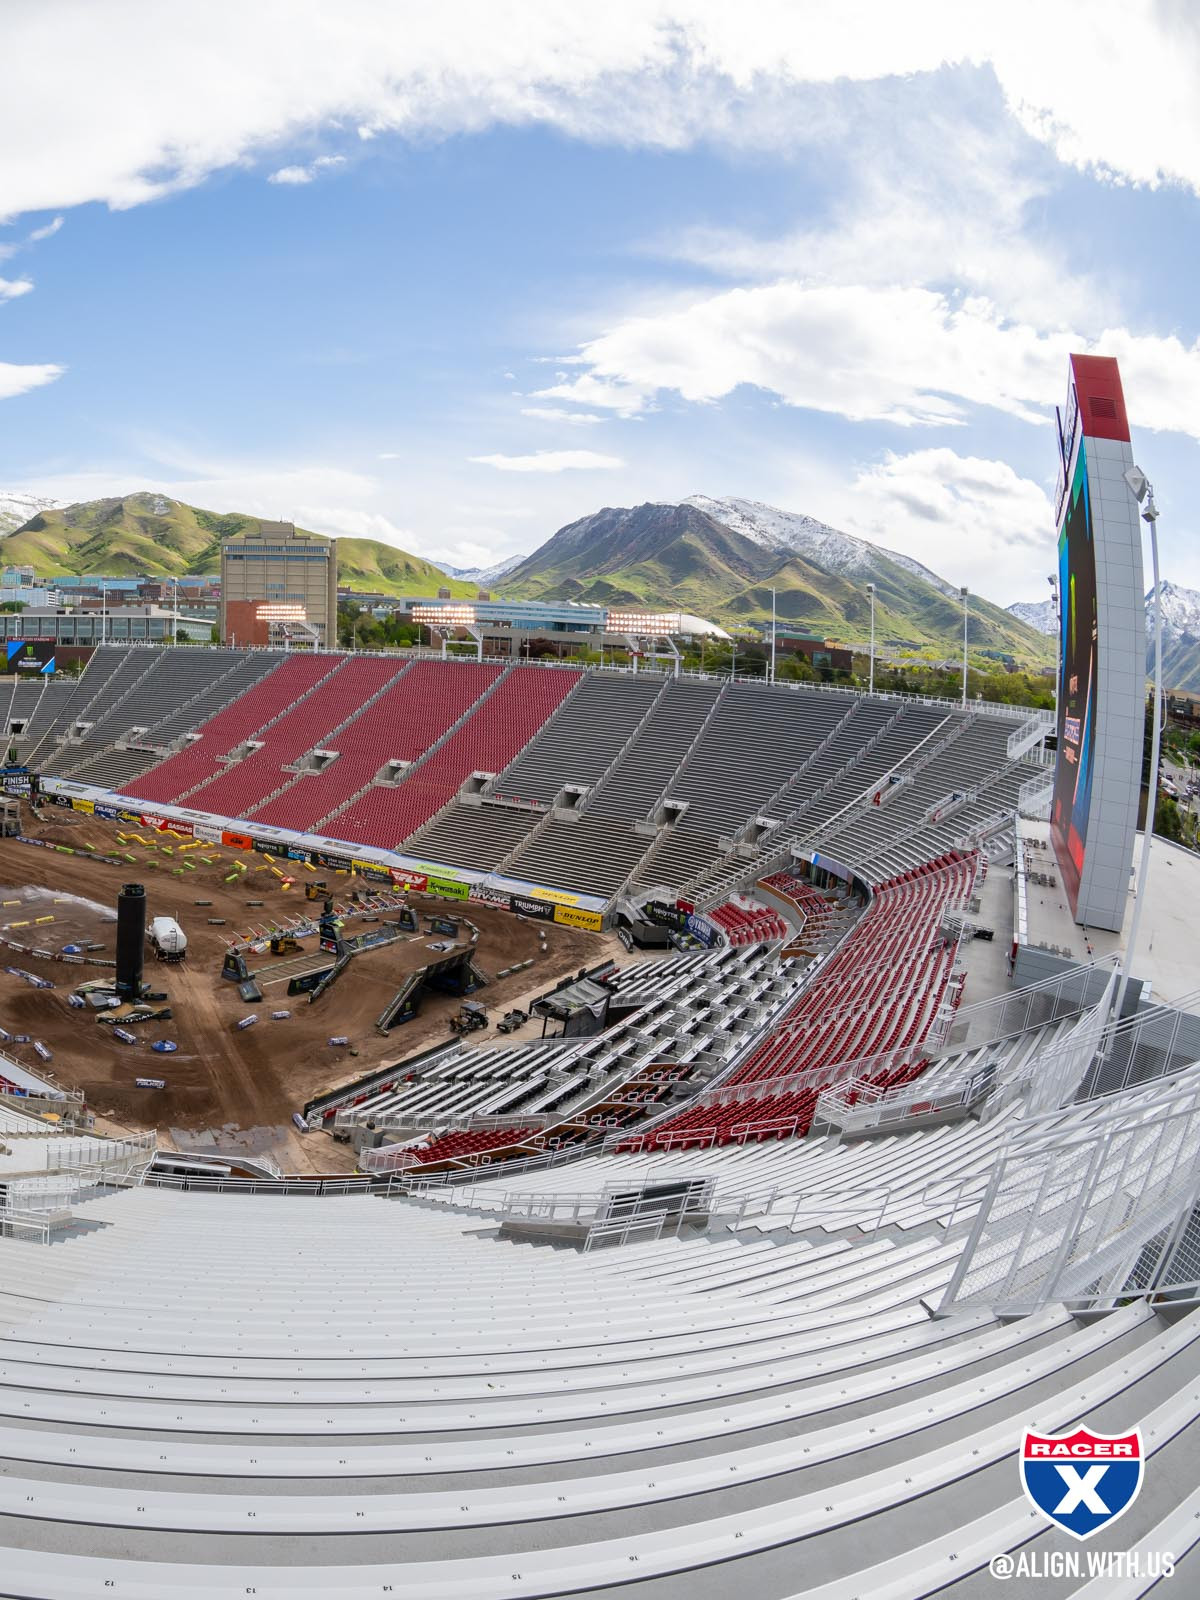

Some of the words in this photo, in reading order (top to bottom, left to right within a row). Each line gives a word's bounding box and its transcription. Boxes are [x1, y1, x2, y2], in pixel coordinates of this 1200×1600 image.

[3, 776, 29, 785] FINISH
[167, 822, 193, 833] GASGAS
[430, 881, 465, 896] Kawasaki
[514, 900, 544, 913] TRIUMPH
[563, 912, 600, 924] DUNLOP
